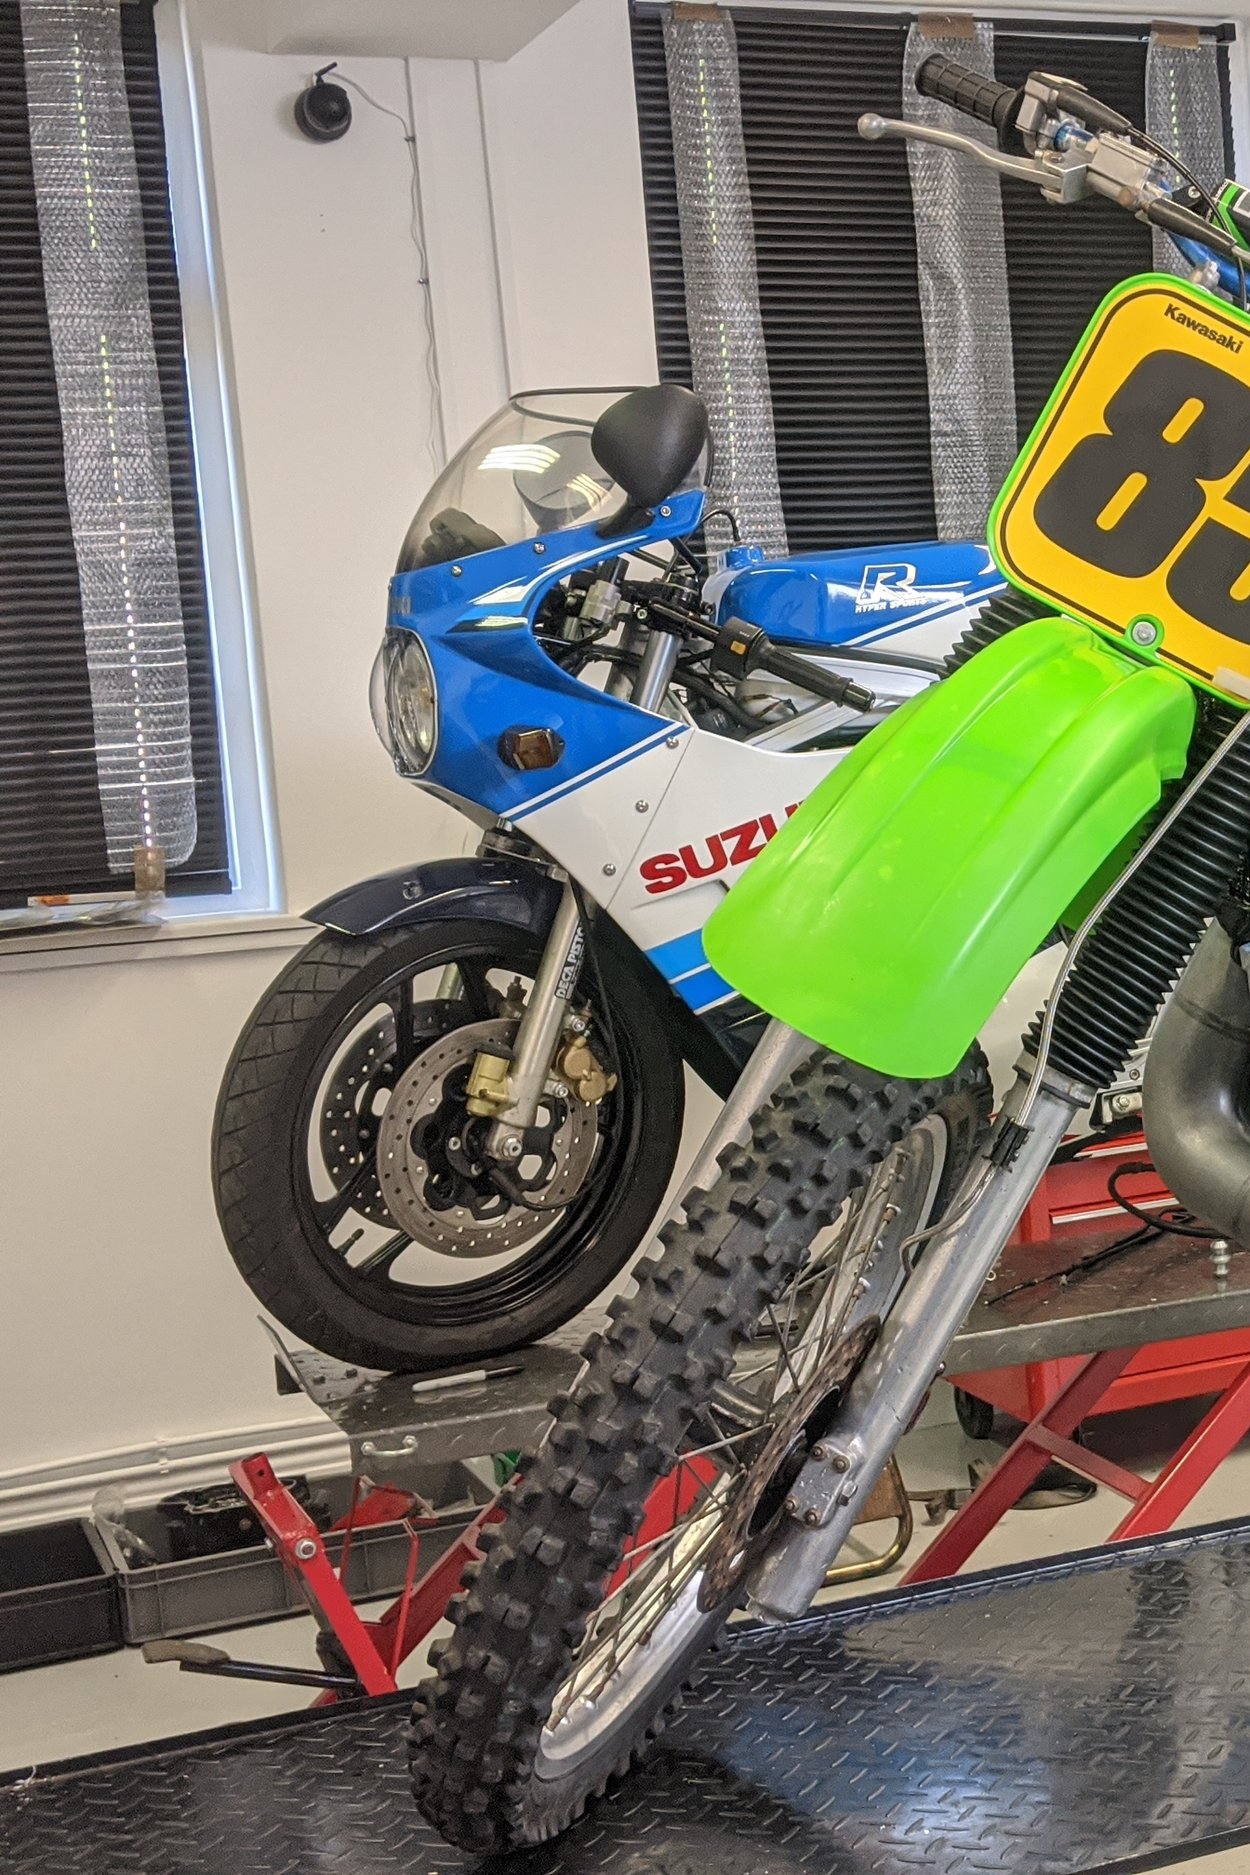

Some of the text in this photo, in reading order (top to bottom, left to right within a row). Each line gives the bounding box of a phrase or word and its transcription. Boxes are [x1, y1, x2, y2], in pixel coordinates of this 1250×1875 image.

[1163, 302, 1245, 355] Kawasaki
[854, 601, 887, 614] HYPER
[555, 965, 575, 999] DECA
